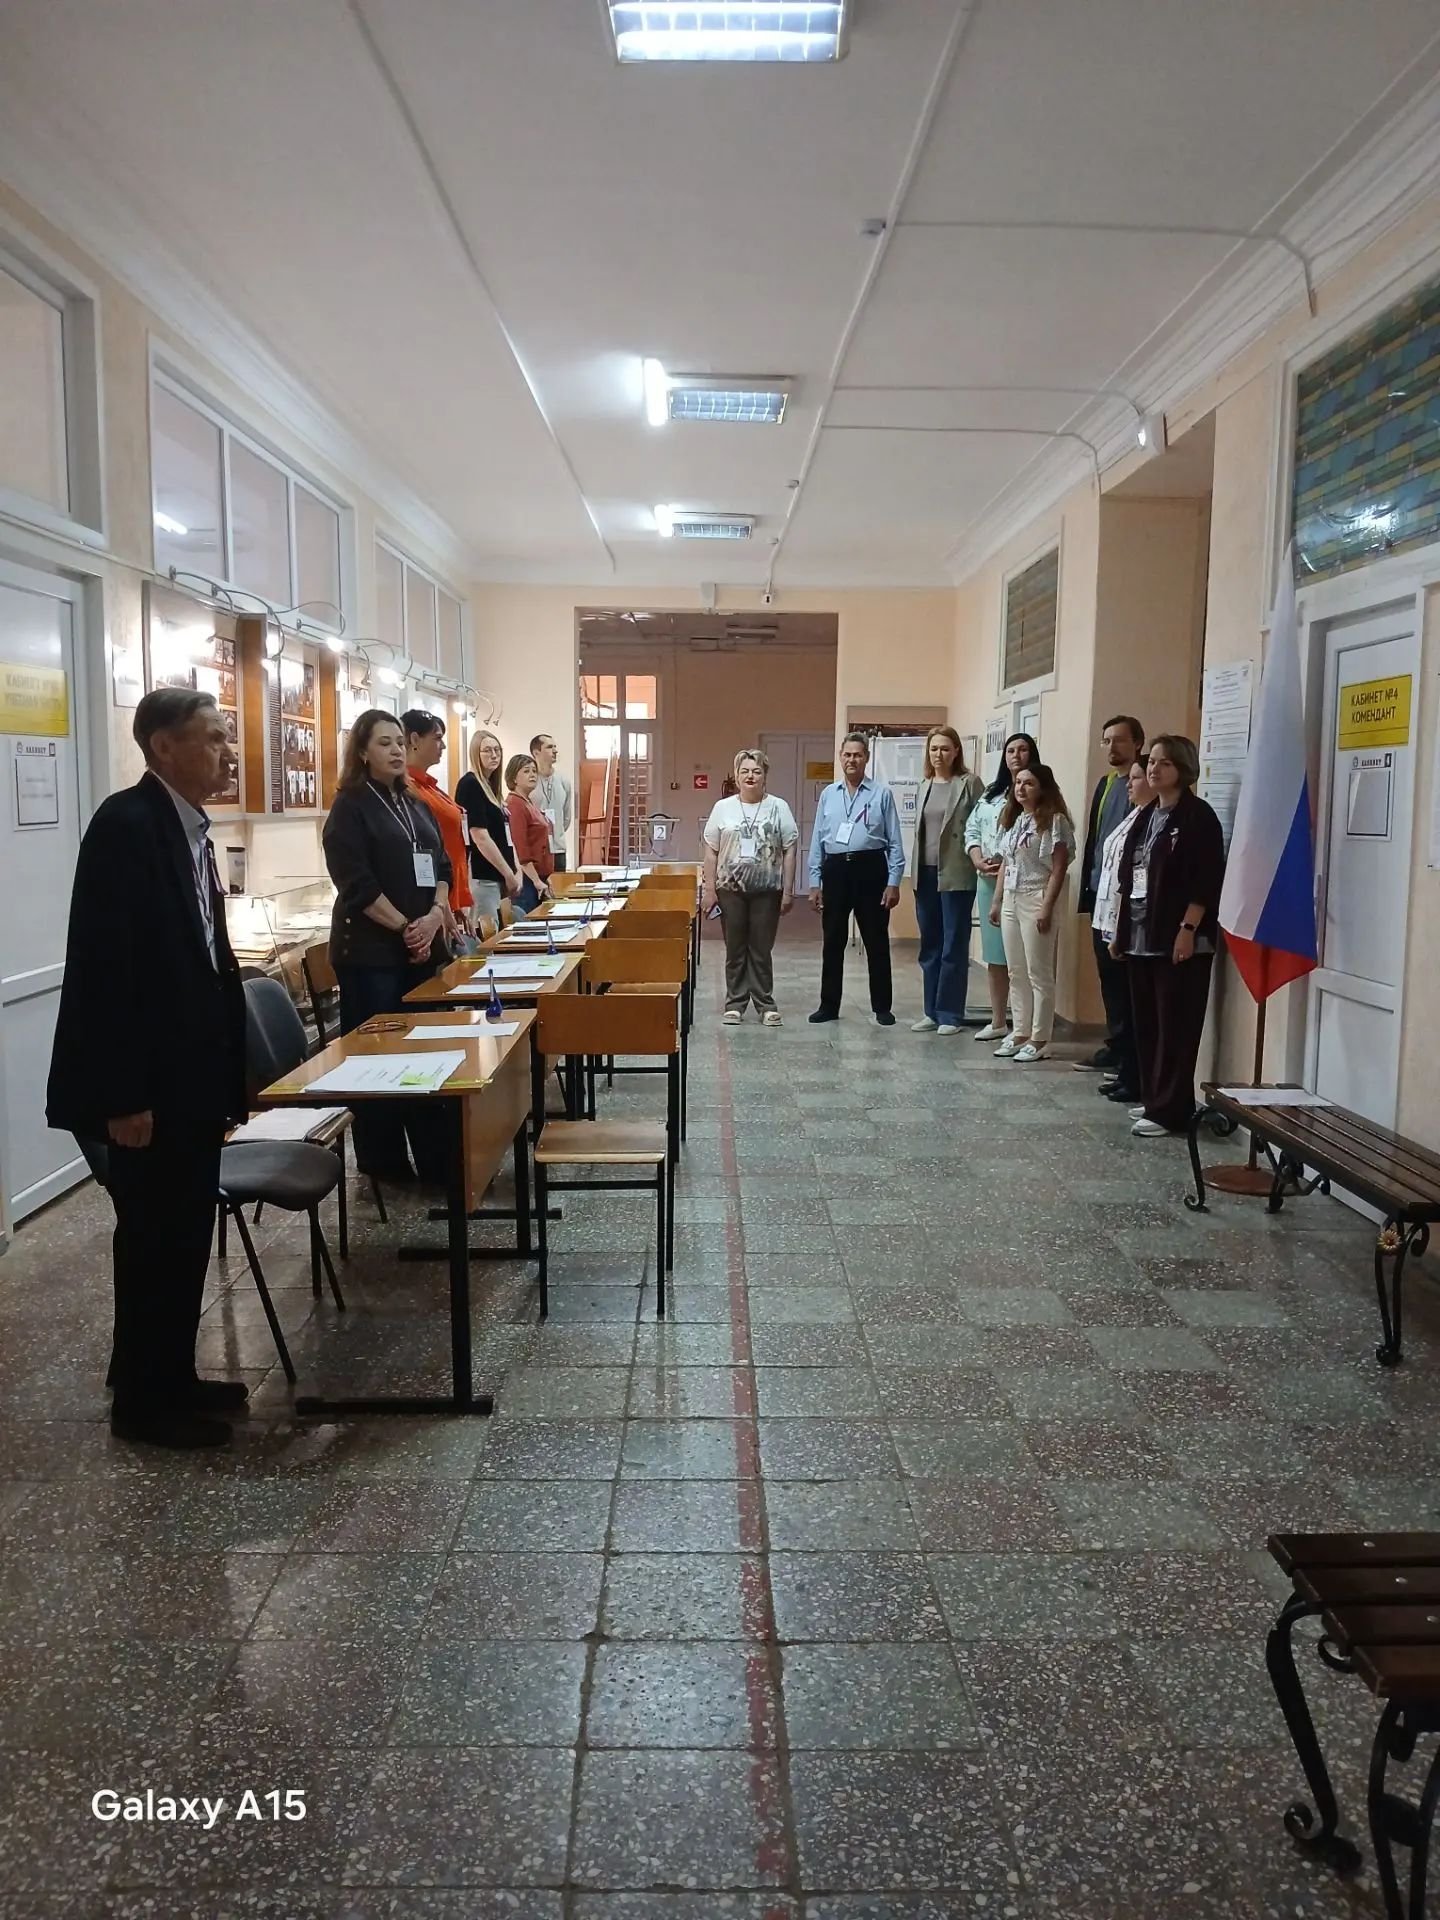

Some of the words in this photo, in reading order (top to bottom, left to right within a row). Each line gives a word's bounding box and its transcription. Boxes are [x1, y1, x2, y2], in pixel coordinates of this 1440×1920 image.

[1351, 690, 1384, 706] КАБИНЕТ
[1385, 688, 1398, 701] №4
[1352, 706, 1396, 723] КОМЕНДАНТ
[905, 802, 914, 810] 18
[657, 827, 664, 839] 2
